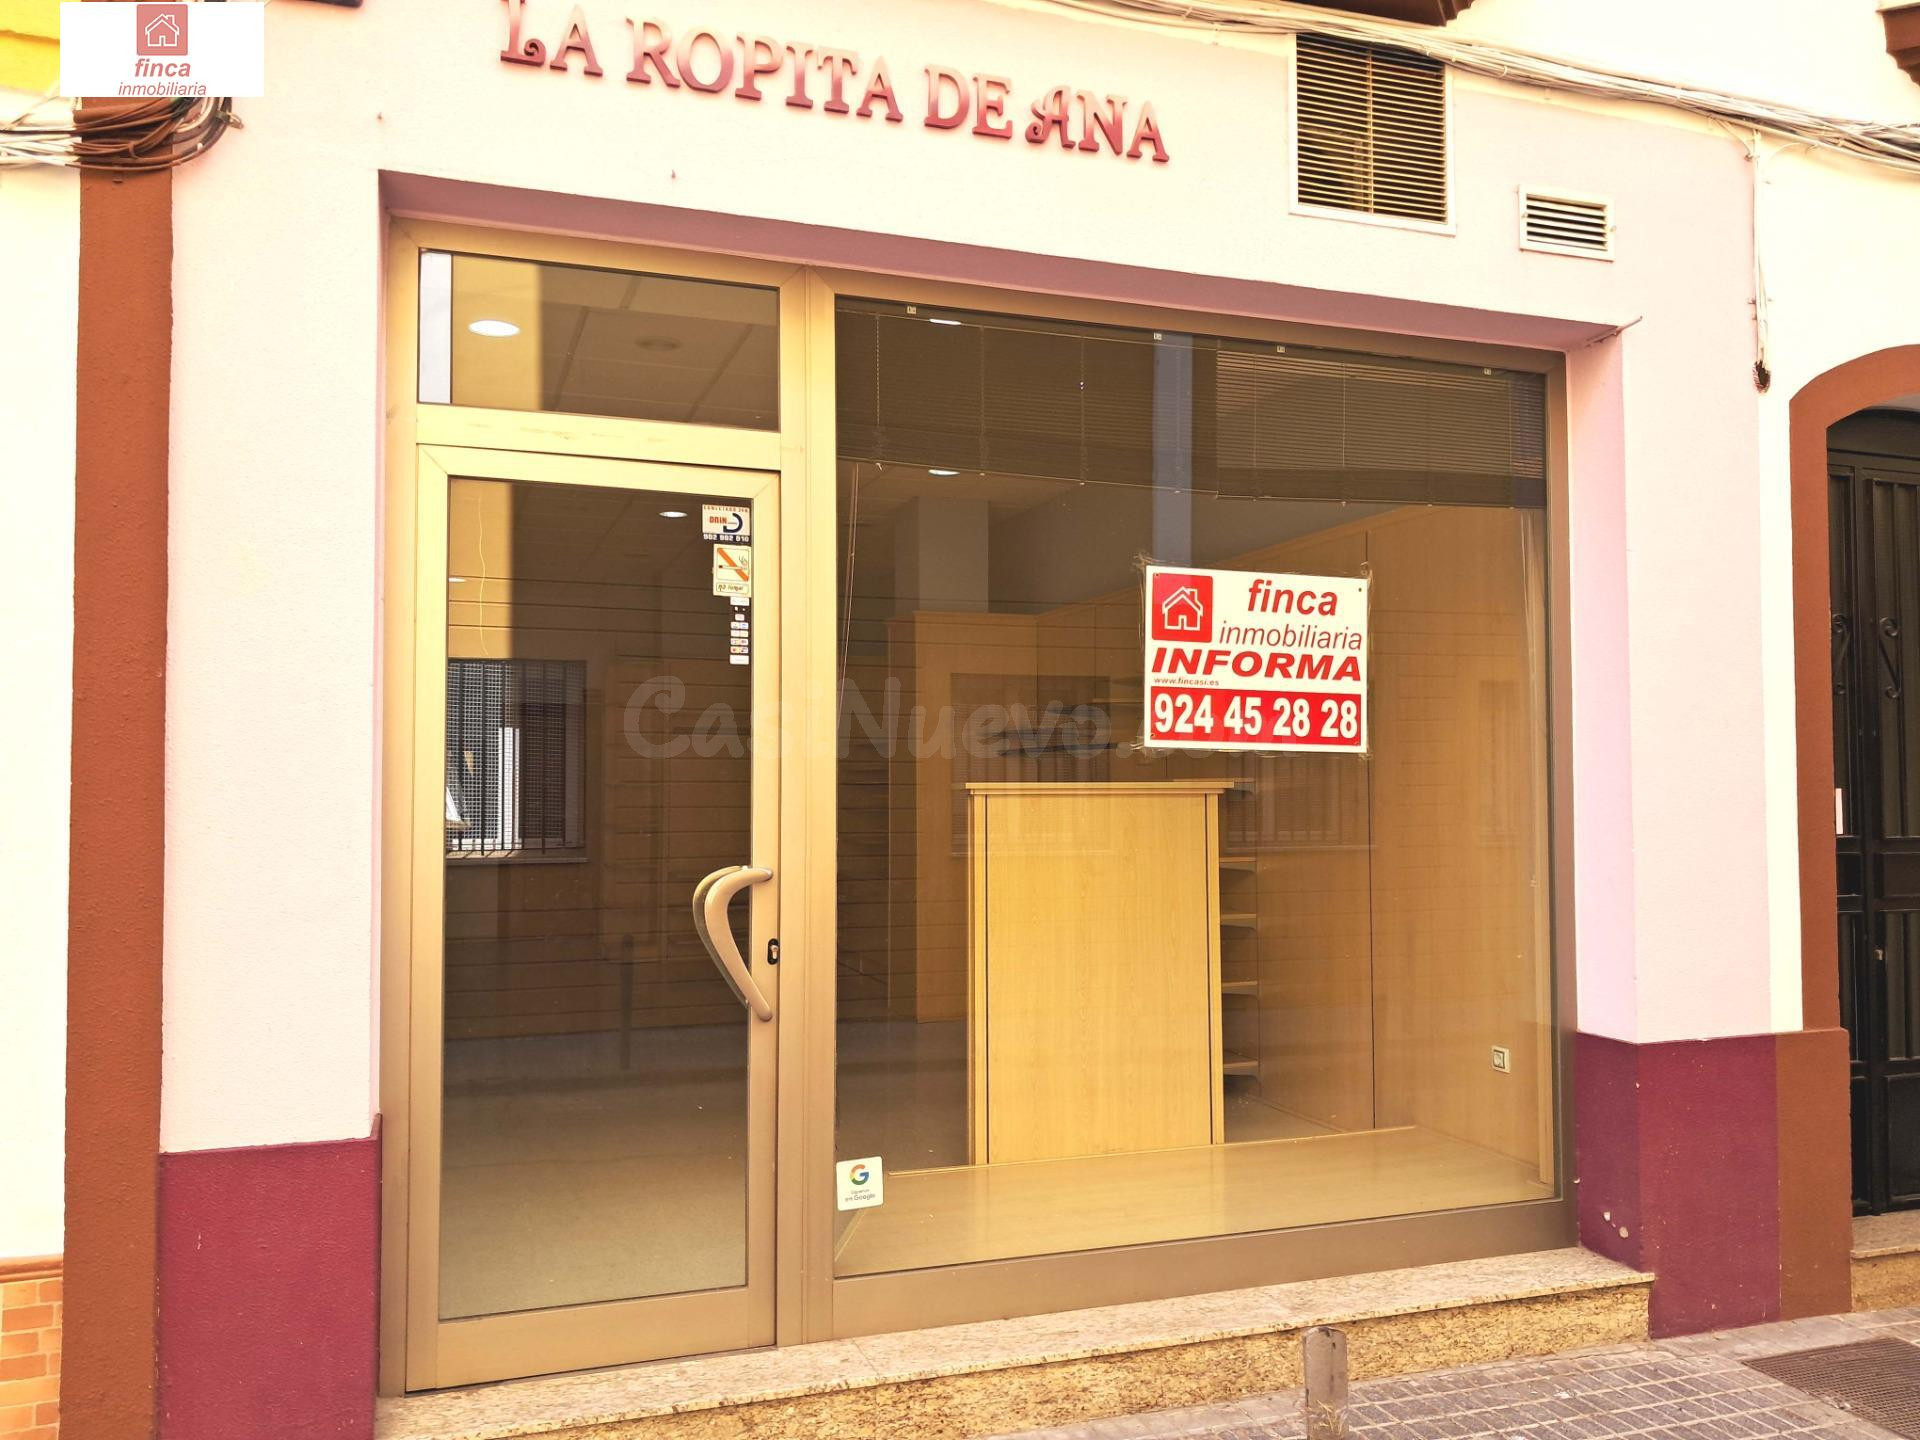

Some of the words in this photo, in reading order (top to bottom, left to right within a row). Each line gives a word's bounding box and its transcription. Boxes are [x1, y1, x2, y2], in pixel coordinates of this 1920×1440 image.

[500, 0, 603, 77] LA
[625, 16, 903, 123] ROPITA
[924, 64, 1014, 139] DE
[1025, 85, 1170, 162] ANA
[1247, 578, 1339, 616] finca
[1219, 620, 1363, 651] inmobiliaria
[1151, 647, 1362, 682] INFORMA
[1153, 676, 1220, 687] www.fincasi.es
[1154, 692, 1214, 734] 924
[1223, 695, 1263, 736] 45
[1272, 697, 1311, 737] 28
[1320, 699, 1358, 739] 28
